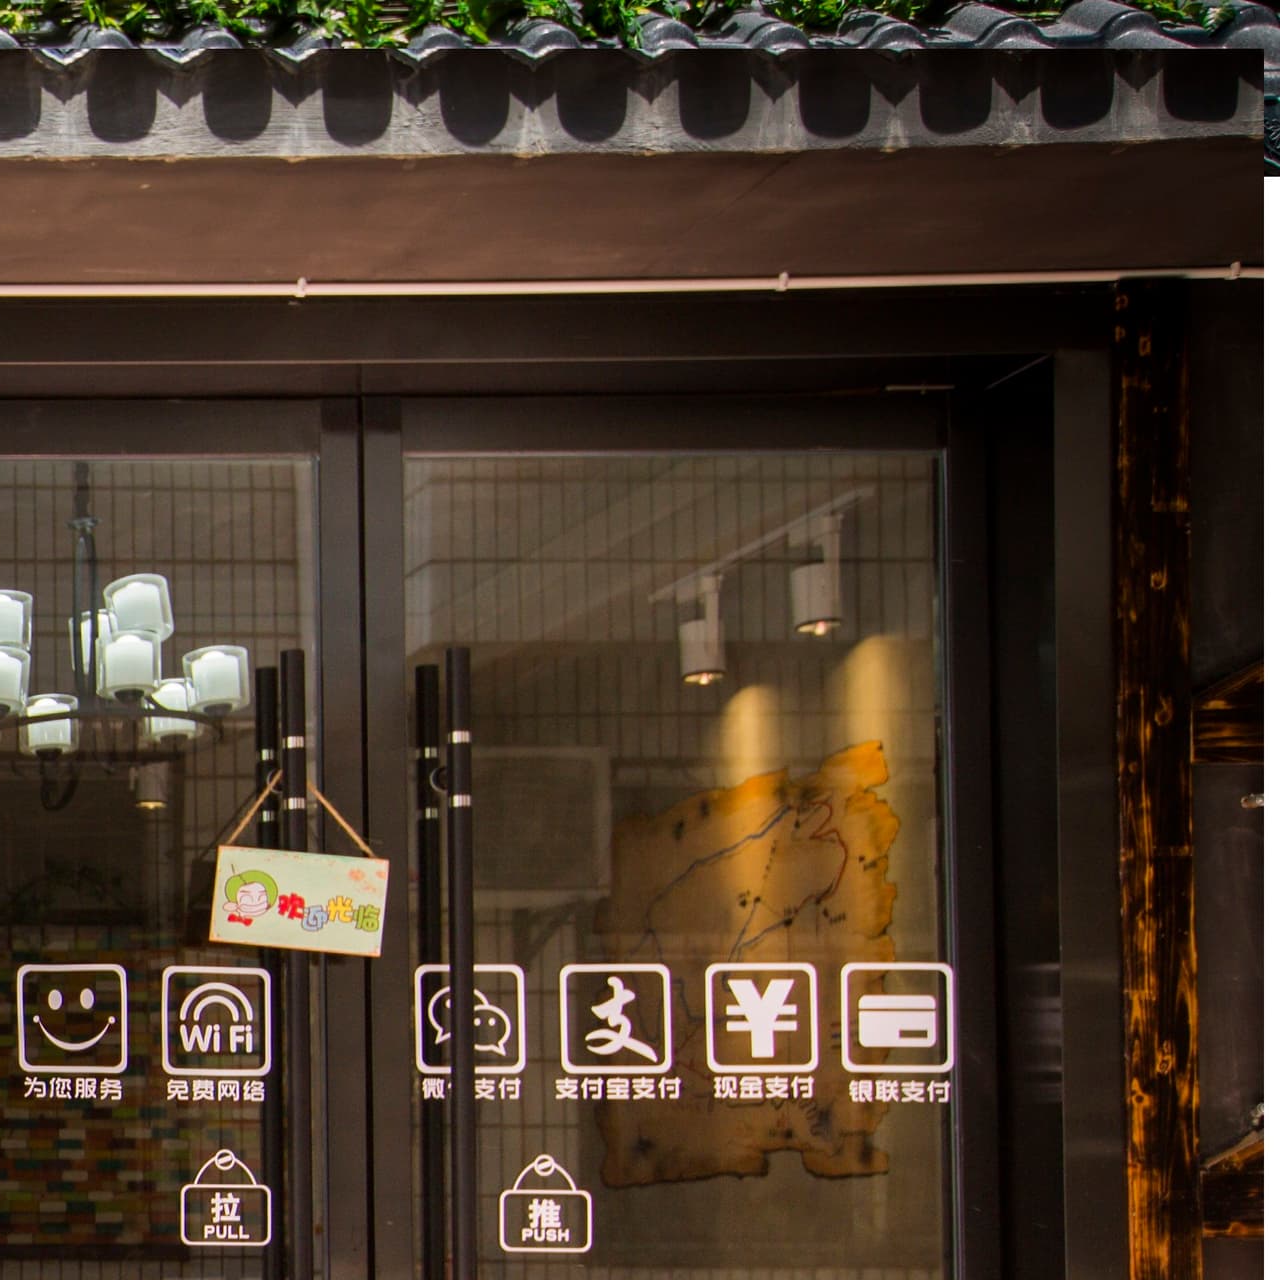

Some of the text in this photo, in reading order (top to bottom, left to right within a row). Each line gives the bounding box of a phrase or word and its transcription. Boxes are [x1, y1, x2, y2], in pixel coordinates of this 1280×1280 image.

[277, 892, 380, 932] 欢迎光临
[24, 1076, 122, 1100] 为您服务
[167, 1079, 265, 1102] 免费网络
[422, 1077, 521, 1100] 微支付
[555, 1077, 681, 1100] 支付宝支付
[714, 1076, 814, 1099] 现金支付
[849, 1080, 950, 1103] 银联支付
[211, 1192, 241, 1223] 拉
[528, 1198, 561, 1228] 推
[204, 1225, 250, 1240] PULL
[521, 1227, 570, 1242] PUSH
